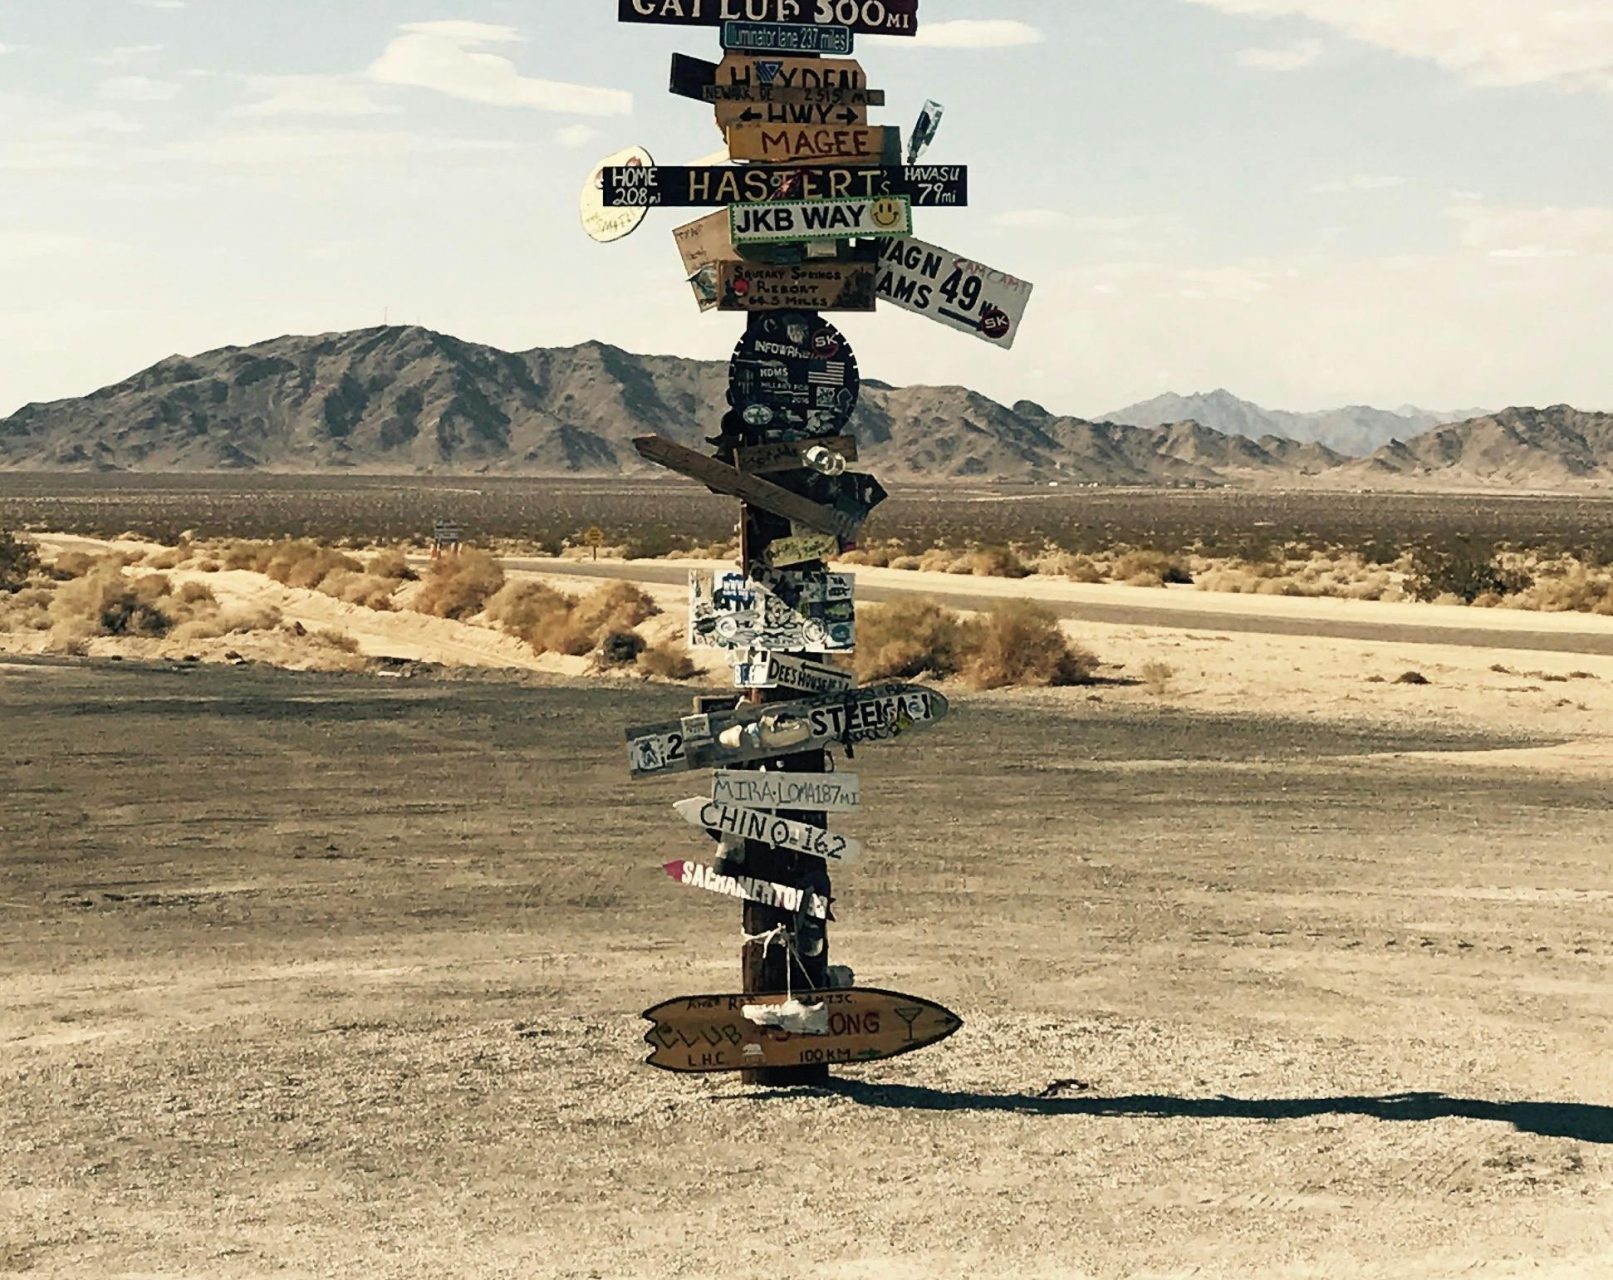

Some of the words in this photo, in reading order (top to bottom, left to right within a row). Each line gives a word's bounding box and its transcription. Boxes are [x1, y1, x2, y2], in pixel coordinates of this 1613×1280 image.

[886, 13, 909, 30] MI
[800, 27, 819, 50] 237
[820, 29, 846, 51] miles
[730, 65, 858, 90] HYDEN
[768, 103, 834, 125] HWY
[761, 130, 870, 154] MAGEE
[612, 167, 659, 187] HOME
[904, 166, 960, 182] HAVASU
[736, 209, 795, 234] JKB
[800, 204, 866, 231] WAY
[939, 267, 982, 312] 49
[785, 295, 828, 307] MILES
[984, 316, 1009, 330] SK
[814, 335, 838, 348] SK
